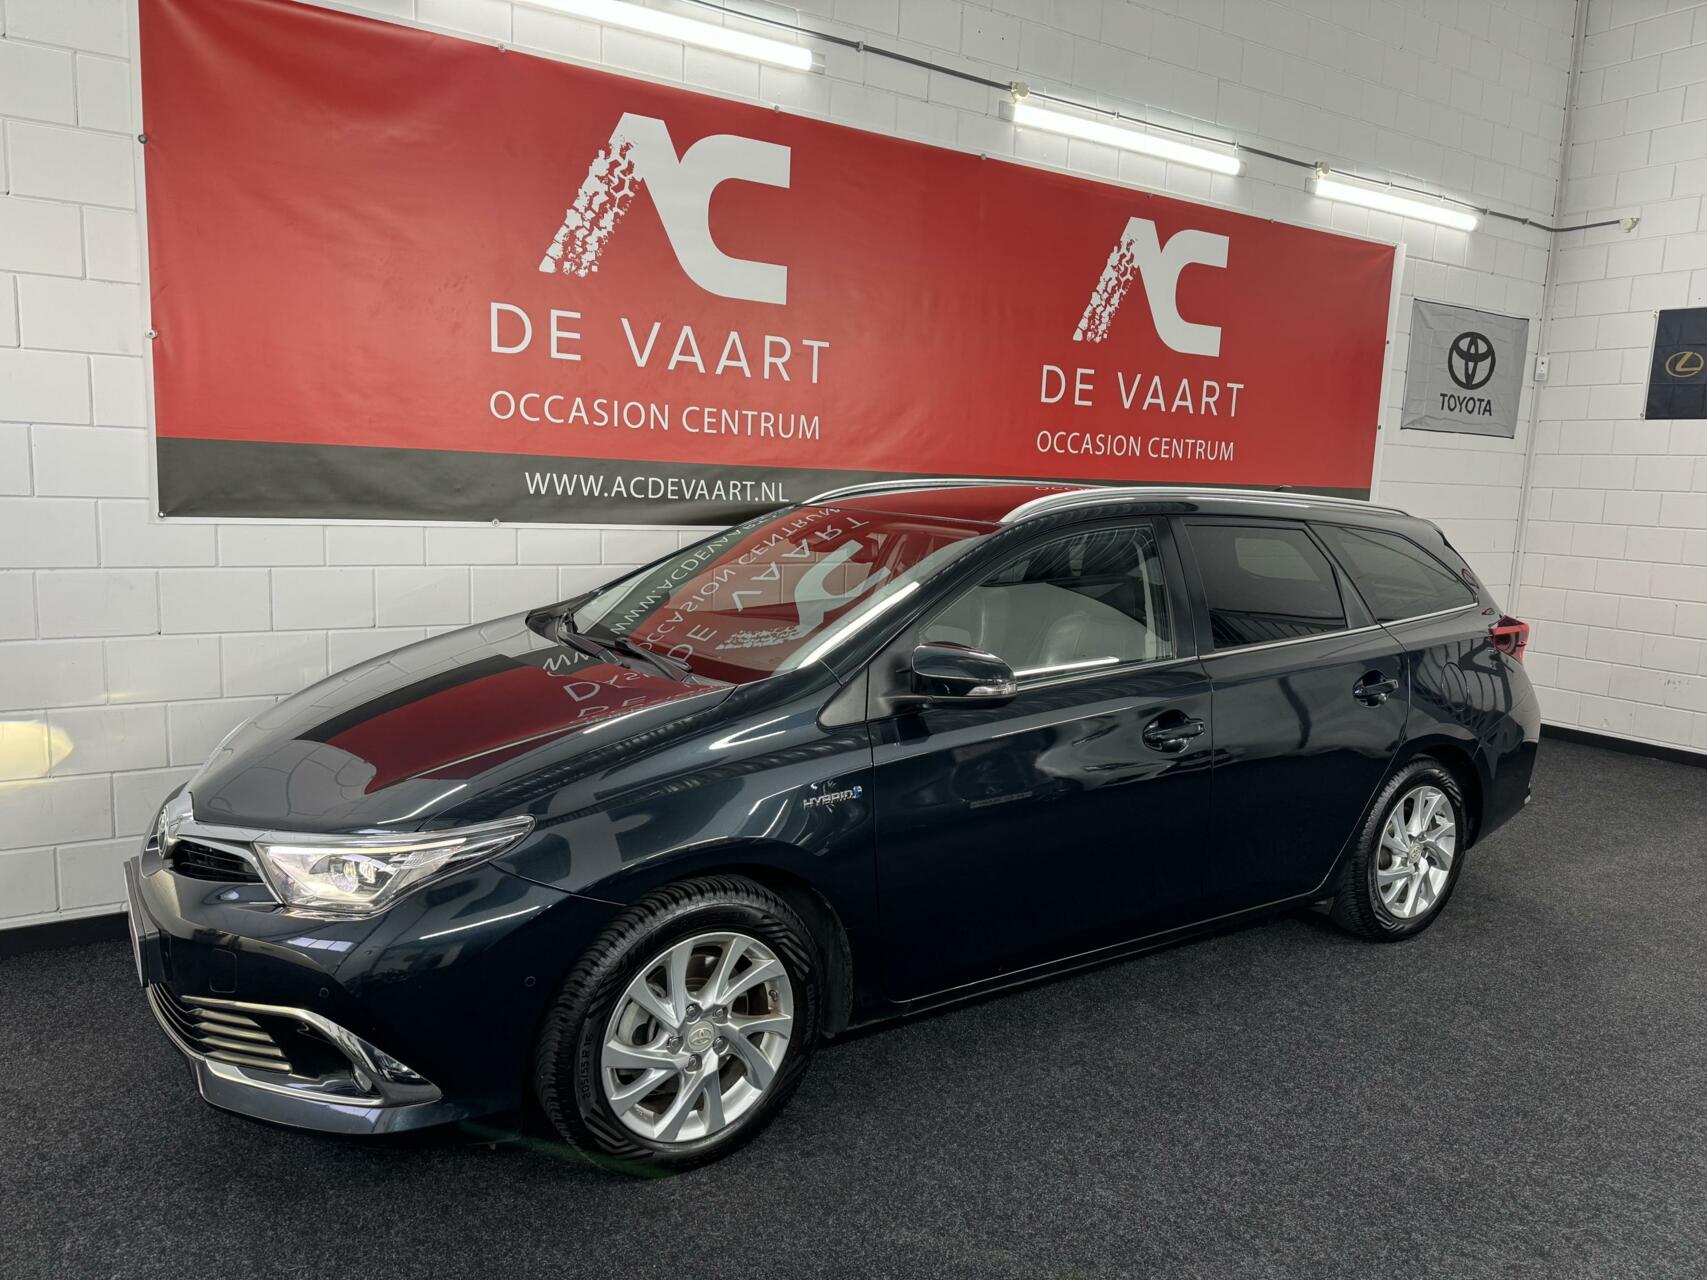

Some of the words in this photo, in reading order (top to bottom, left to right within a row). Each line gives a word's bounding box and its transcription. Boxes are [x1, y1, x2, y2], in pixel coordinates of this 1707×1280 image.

[538, 112, 791, 305] AC
[1072, 216, 1230, 357] AC
[490, 302, 582, 361] DE
[621, 317, 830, 384] VAART
[489, 390, 669, 431] OCCASION
[682, 406, 820, 440] CENTRUM
[1040, 364, 1095, 406] DE
[1117, 371, 1244, 417] VAART
[1439, 393, 1492, 416] TOYOTA
[1036, 430, 1141, 457] OCCASION
[1148, 436, 1234, 461] CENTRUM
[525, 471, 789, 503] WWW.ACDEVAART.NL
[803, 789, 854, 809] HYBRID
